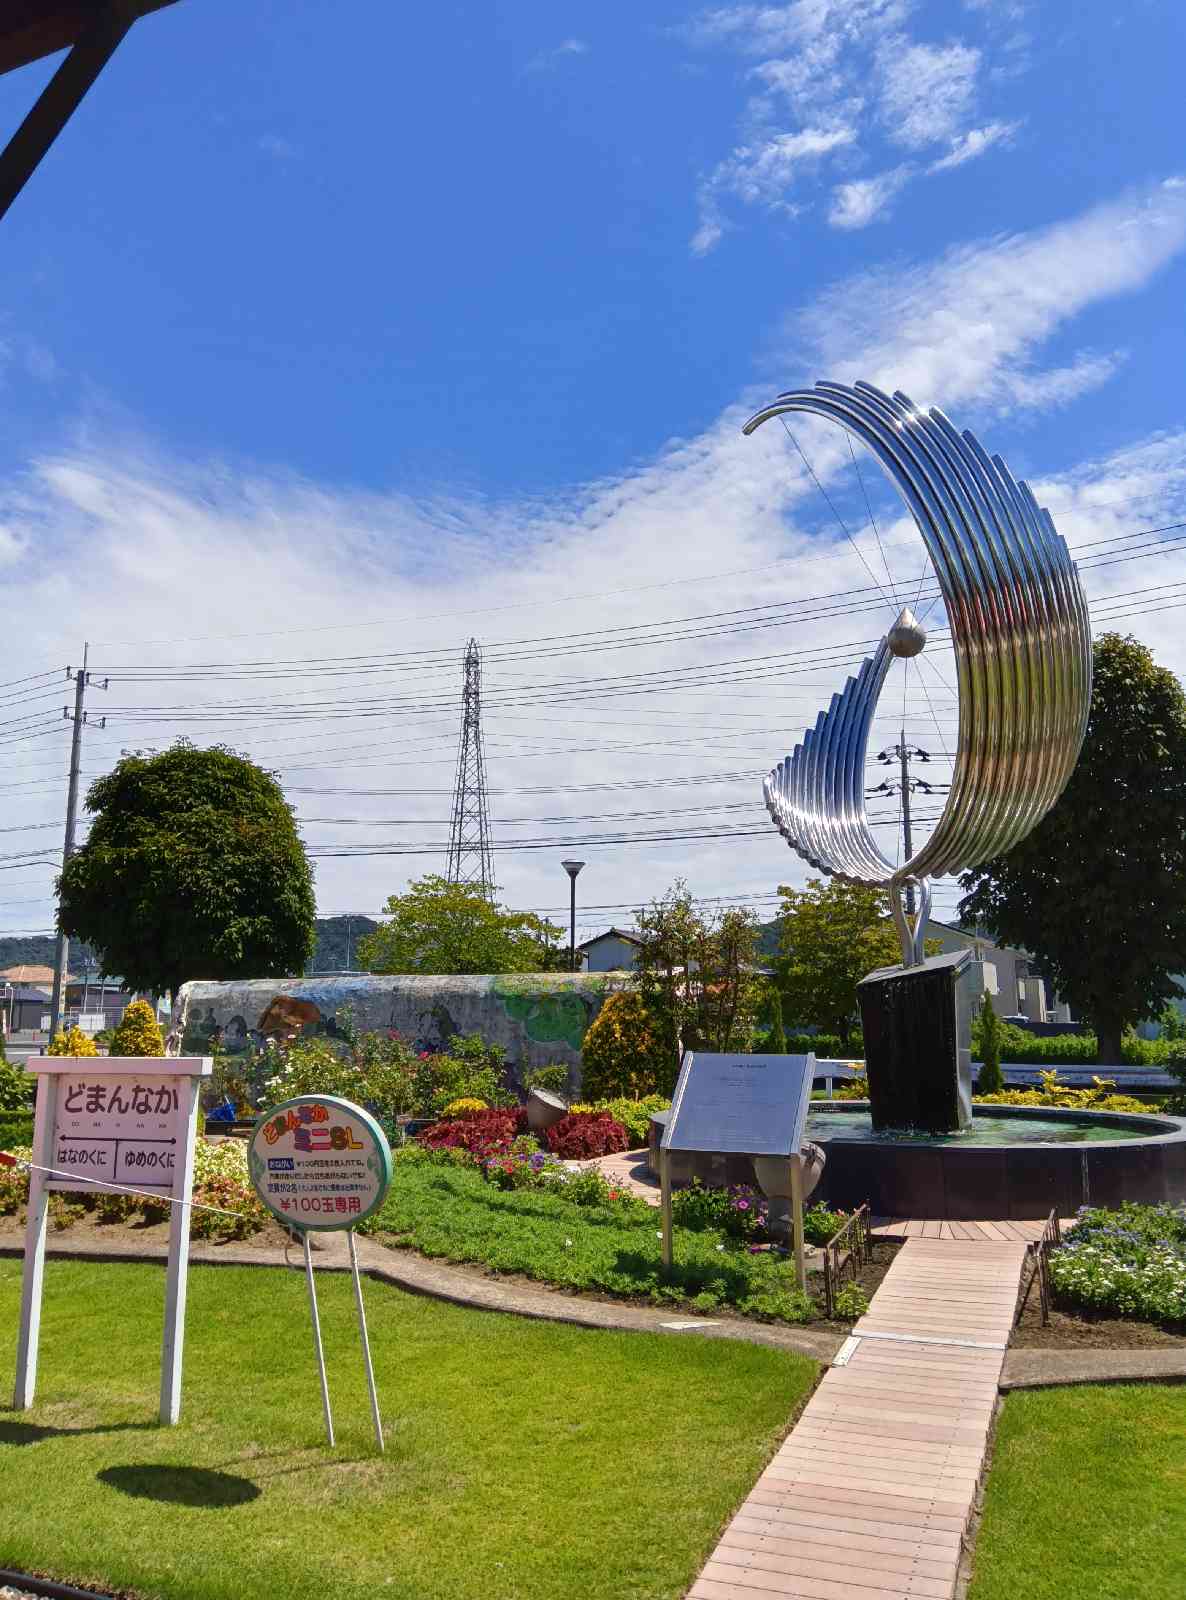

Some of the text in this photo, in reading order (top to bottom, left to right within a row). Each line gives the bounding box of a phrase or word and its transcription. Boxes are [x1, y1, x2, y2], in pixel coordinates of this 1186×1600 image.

[65, 1083, 178, 1114] どまんなか
[57, 1149, 107, 1165] はなのくに
[124, 1151, 176, 1168] ゆめのくに
[280, 1197, 361, 1213] ¥100玉専用
